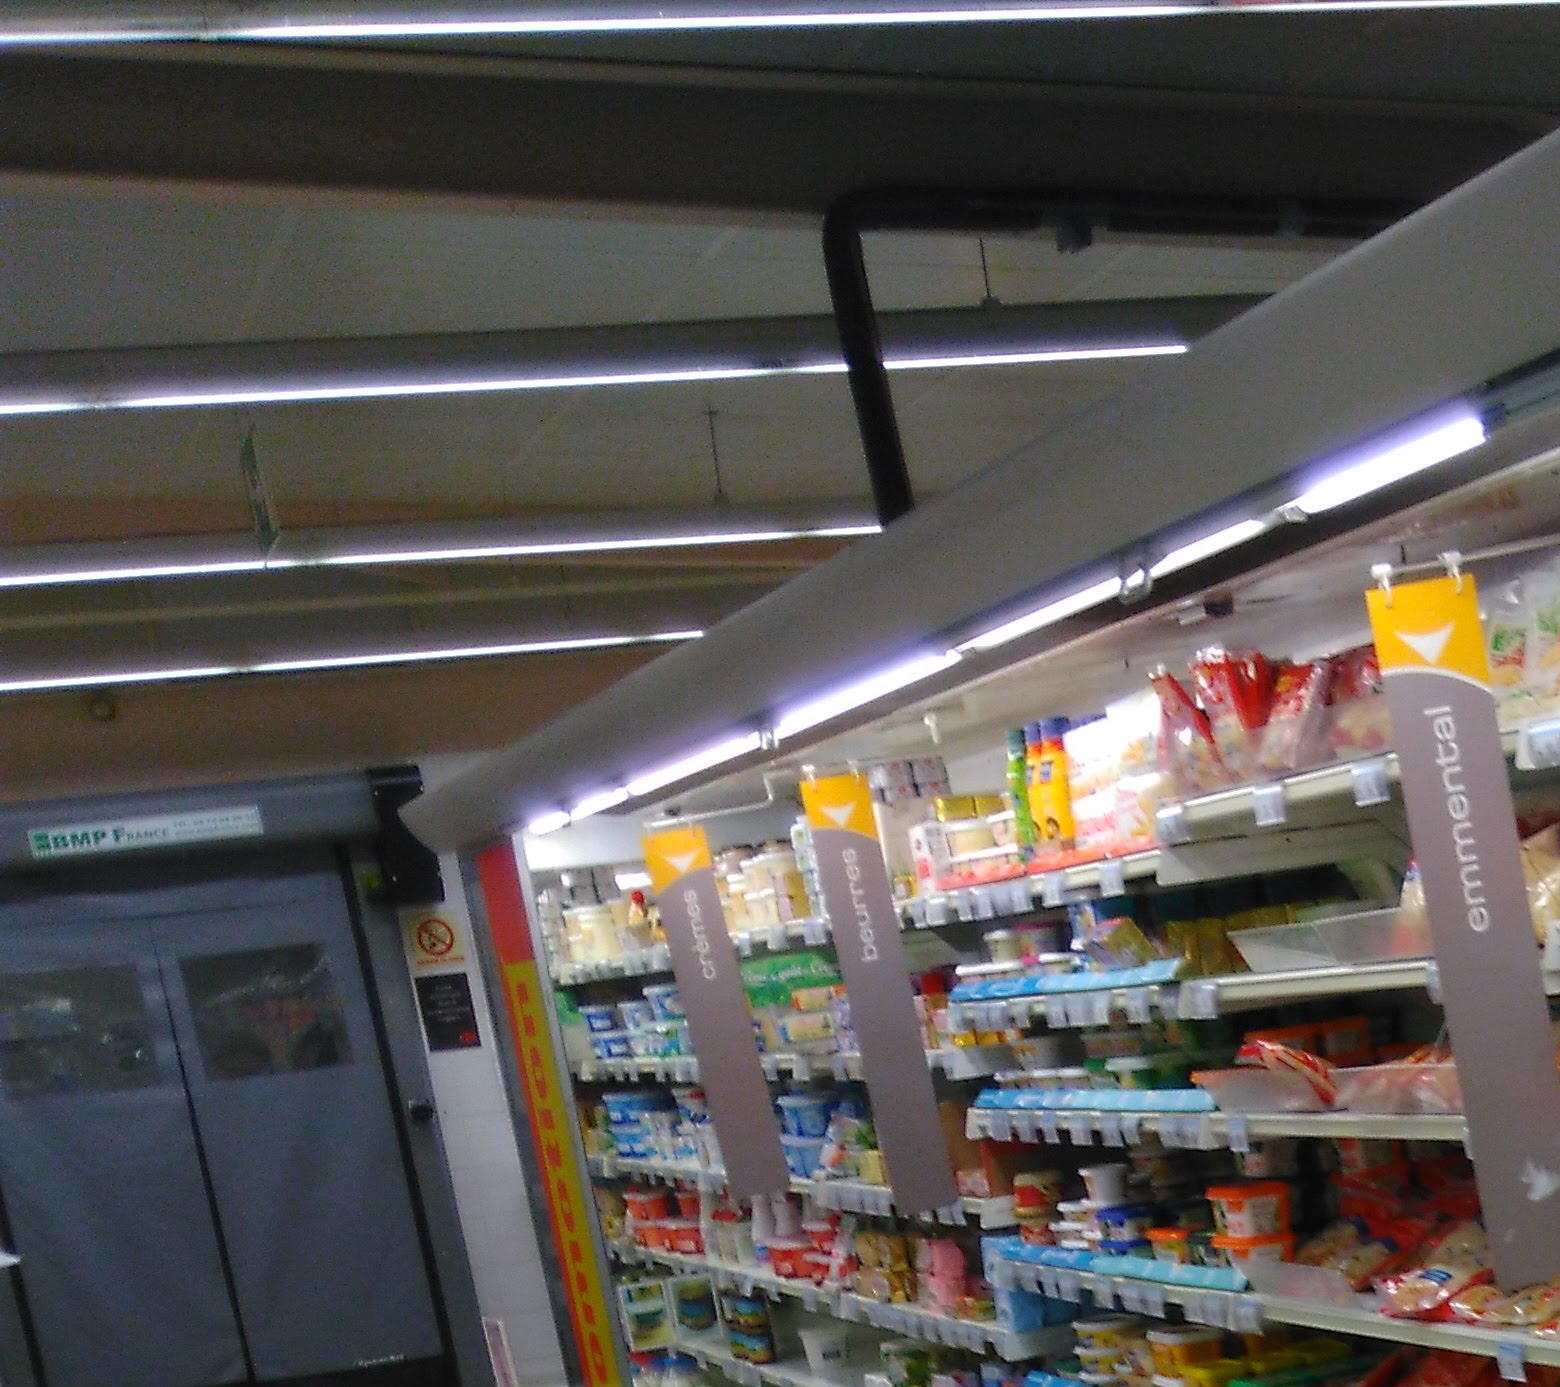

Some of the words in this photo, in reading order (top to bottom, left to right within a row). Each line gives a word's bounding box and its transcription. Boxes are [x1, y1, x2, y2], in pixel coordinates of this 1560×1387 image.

[1424, 705, 1490, 933] emmental
[684, 889, 717, 982] crèmes
[842, 848, 880, 962] beurres
